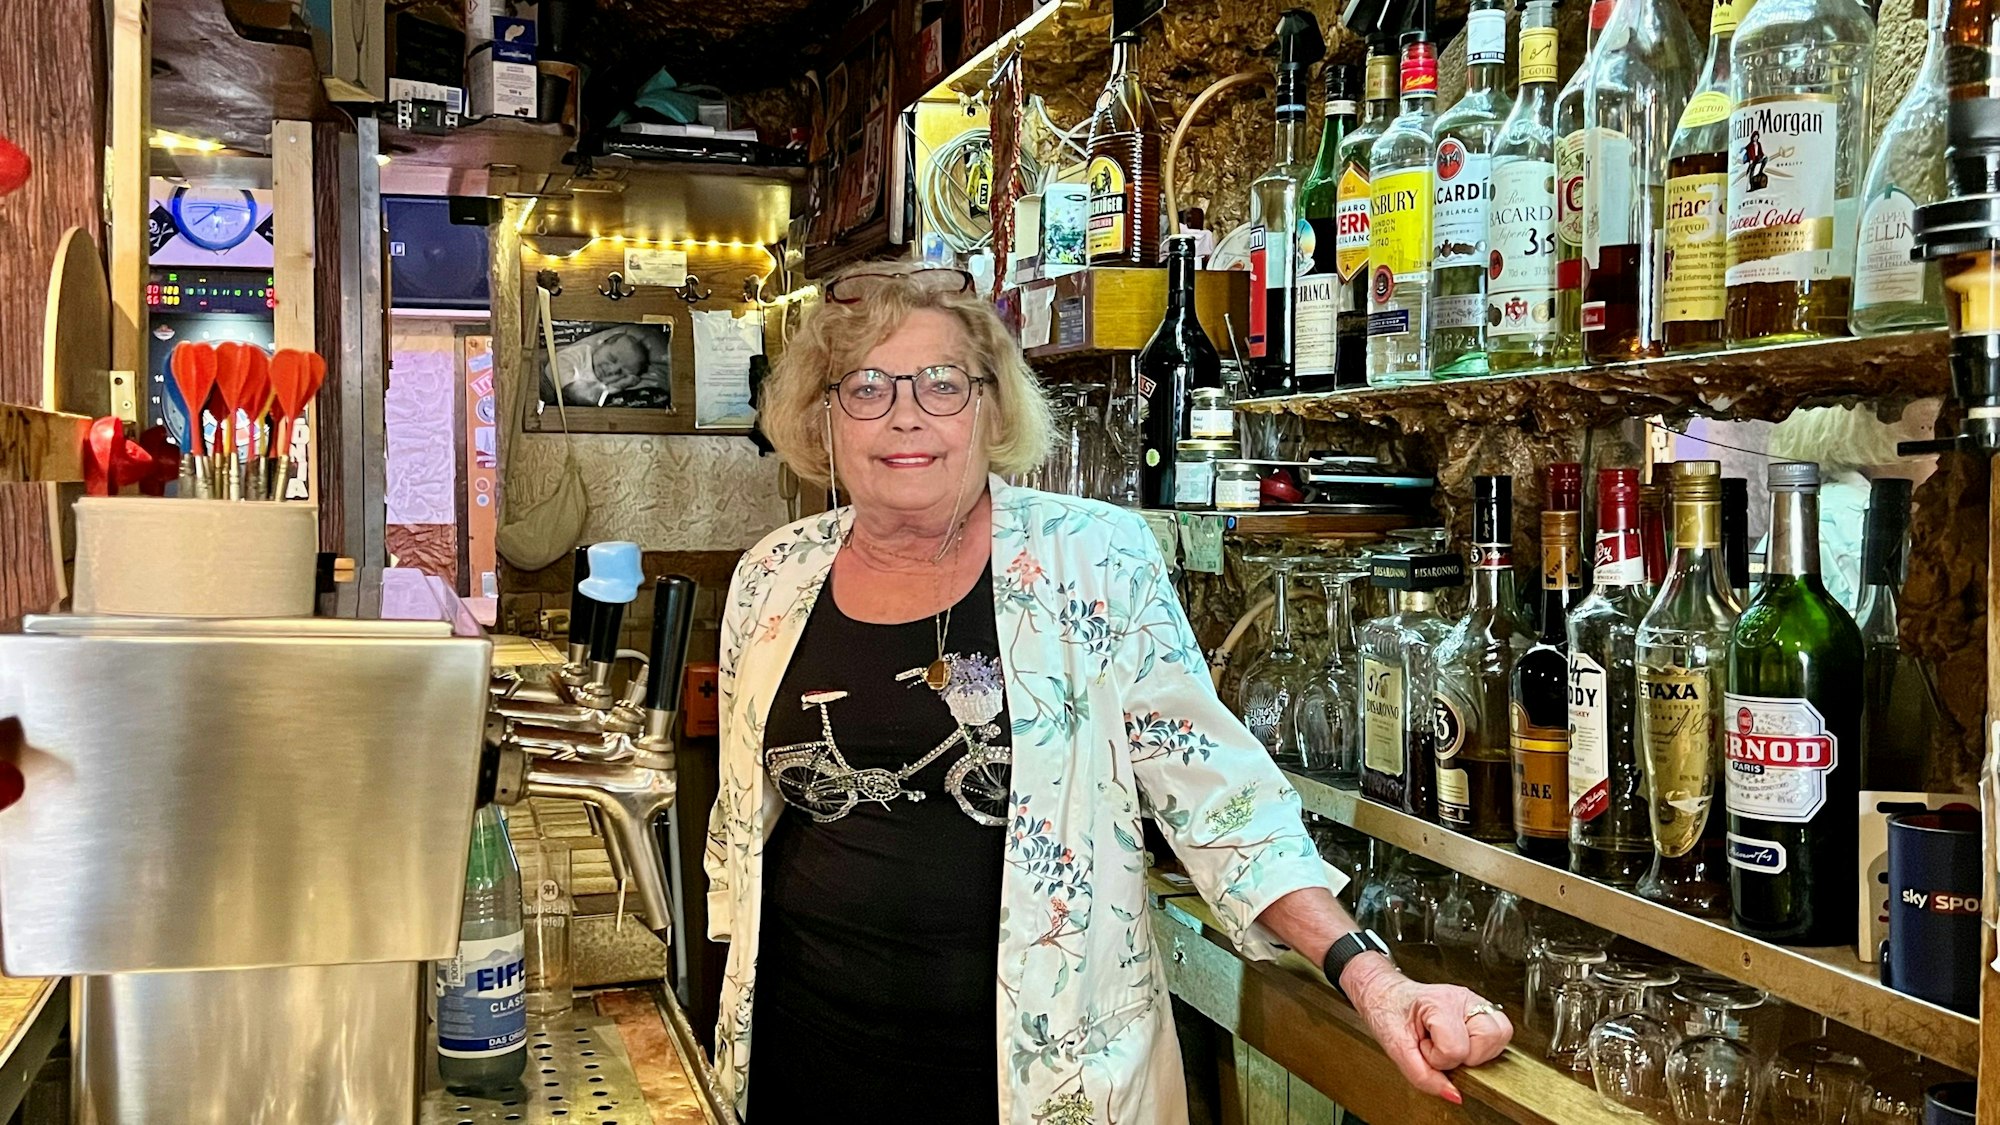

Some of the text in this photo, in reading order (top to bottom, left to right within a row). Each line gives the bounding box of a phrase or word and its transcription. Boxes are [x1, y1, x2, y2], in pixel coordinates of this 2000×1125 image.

[1529, 69, 1552, 77] GOLD
[1755, 108, 1822, 136] Morgan
[1446, 208, 1478, 217] BLANCA
[1764, 207, 1804, 228] Gold
[1373, 566, 1407, 578] DISARONNO
[1415, 564, 1459, 578] DISARONNO
[1366, 698, 1399, 720] DISARONNO
[1733, 761, 1761, 773] PARIS
[1902, 888, 1928, 909] sky
[489, 1036, 507, 1047] DAS
